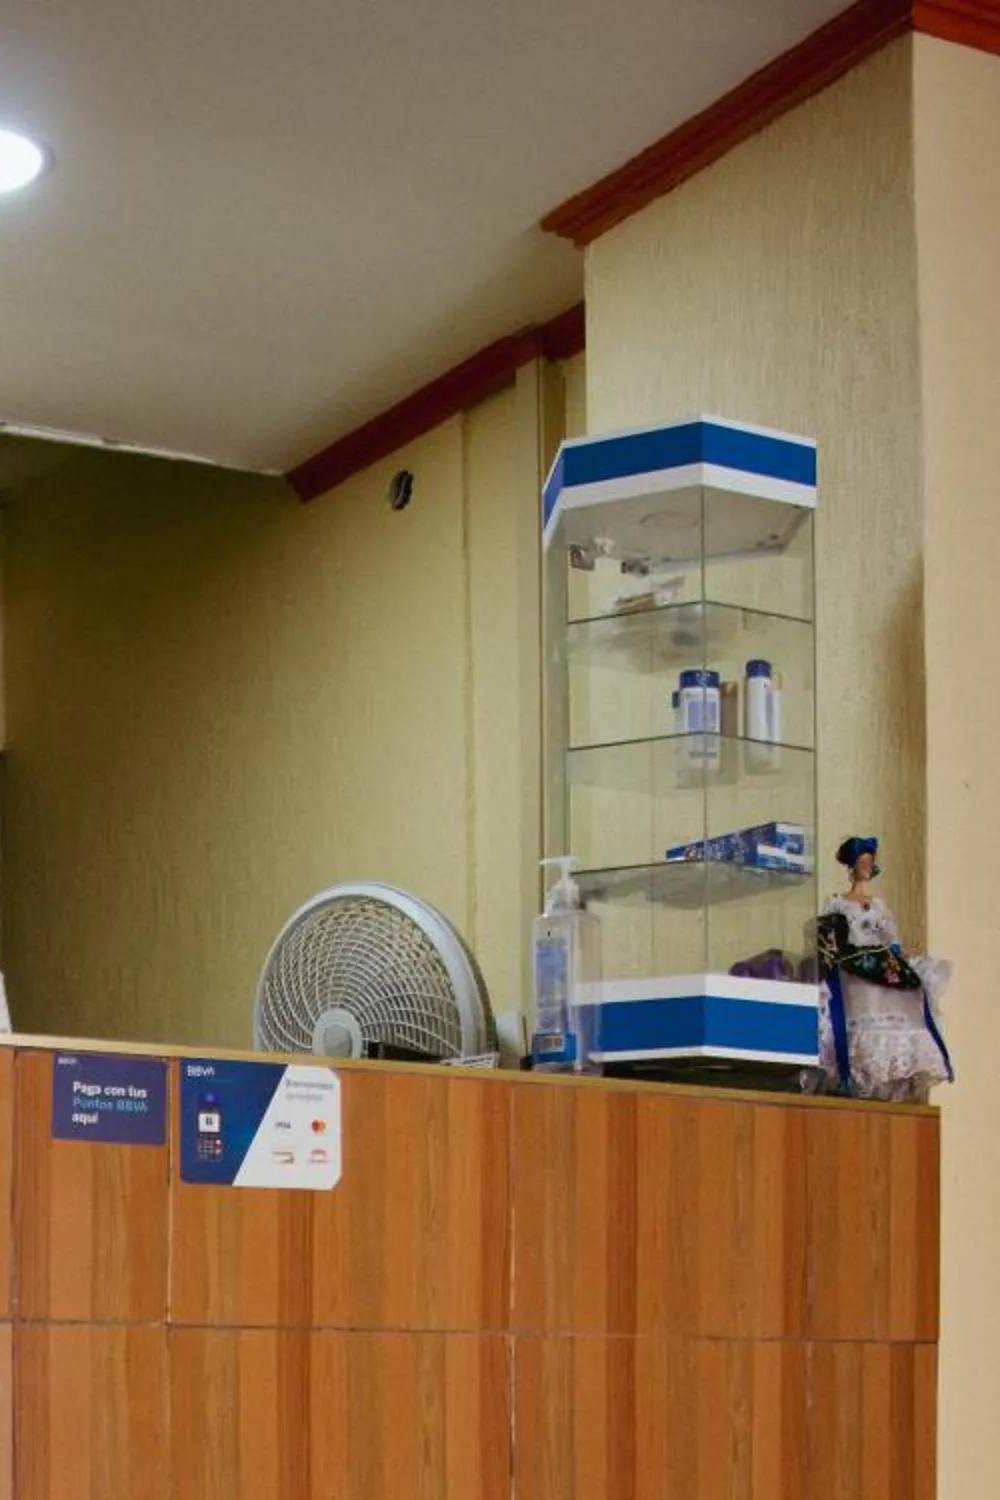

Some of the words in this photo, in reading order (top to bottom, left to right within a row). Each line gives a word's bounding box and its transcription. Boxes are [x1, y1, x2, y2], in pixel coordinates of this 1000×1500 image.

[187, 1065, 215, 1077] BBVA
[104, 1086, 126, 1097] con
[127, 1085, 148, 1099] tus
[72, 1097, 114, 1111] Puntos
[116, 1099, 149, 1113] BBVA
[71, 1111, 99, 1126] aquí
